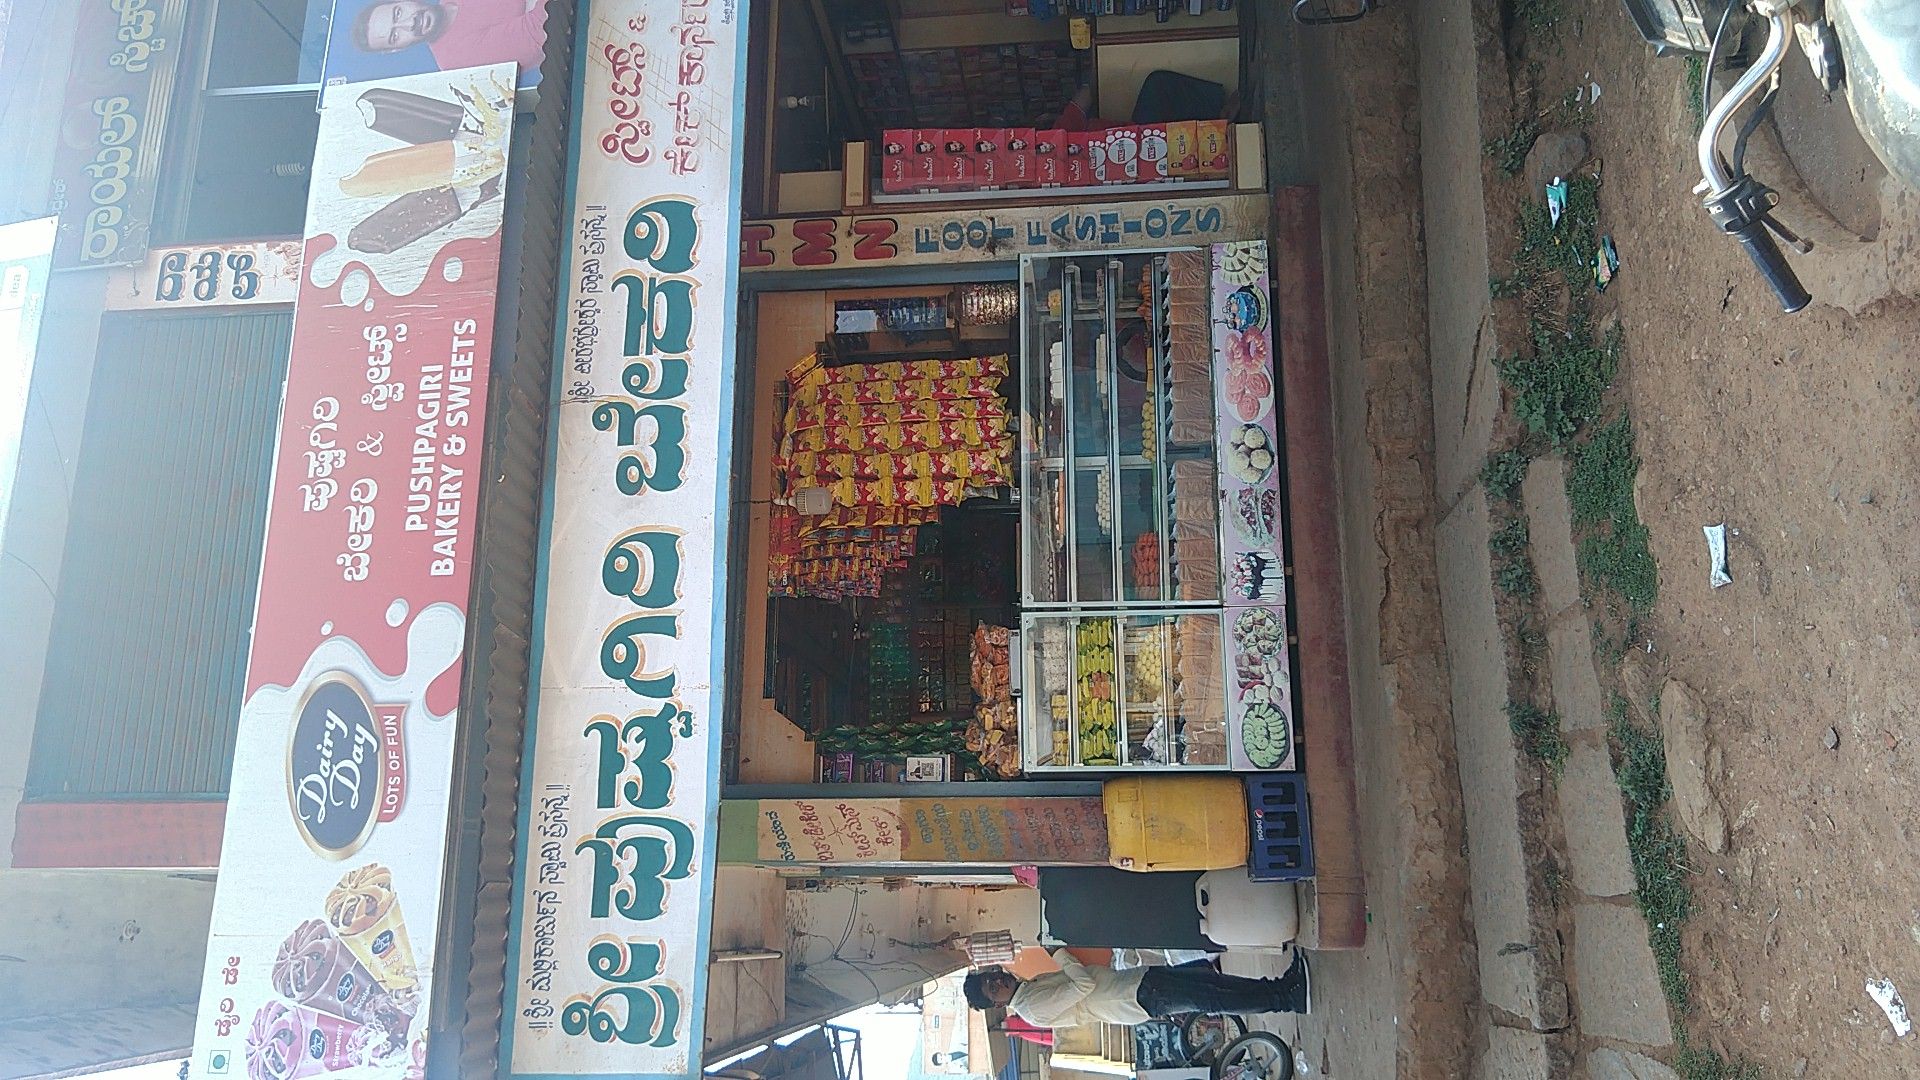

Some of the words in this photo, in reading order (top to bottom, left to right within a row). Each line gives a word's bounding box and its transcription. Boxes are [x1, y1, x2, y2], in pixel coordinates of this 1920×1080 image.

[600, 42, 651, 165] ಸ್ವೀಟ್ಸ್
[663, 91, 702, 176] ಕೇಕ್
[80, 96, 138, 261] ರಾಯಲ್
[579, 214, 607, 255] ಪ್ರಸನ್ನ
[914, 220, 1016, 254] FOOT
[155, 250, 263, 302] ರಾಯಲ್
[579, 259, 604, 293] ಸ್ವಾಮಿ
[571, 298, 602, 374] ವೀರಭದ್ರೇಶ್ವರ
[591, 197, 699, 496] ಬೇಕರಿ
[361, 323, 408, 411] ಸ್ವೀಟ್ಸ್
[448, 318, 477, 426] SWEETS
[566, 380, 595, 397] ಶ್ರೀ
[297, 396, 347, 512] ಪುಷ್ಪಗಿರಿ
[356, 431, 384, 457] &
[405, 363, 444, 531] PUSHPAGIRI
[444, 434, 467, 456] &
[336, 478, 378, 582] ಬೇಕರಿ
[430, 463, 464, 577] BAKERY
[382, 714, 399, 745] FUN
[574, 531, 696, 921] ಪುಷ್ಪಗಿರಿ
[296, 707, 348, 824] Dairy
[329, 722, 378, 809] Day
[384, 750, 400, 770] OF
[383, 776, 401, 814] LOTS
[538, 793, 570, 838] ಪ್ರಸನ್ನ
[868, 815, 896, 846] ಕೇಕ್
[1255, 820, 1265, 841] pepsi
[538, 842, 567, 885] ಸ್ವಾಮಿ
[526, 889, 561, 992] ಮಲ್ಲಿಕಾರ್ಜುನ
[222, 956, 240, 985] ಡೇ
[560, 938, 680, 1048] ಶ್ರೀ
[214, 998, 240, 1037] ಡೈರಿ
[522, 998, 554, 1019] ಶ್ರೀ
[332, 1024, 345, 1067] Strawberry
